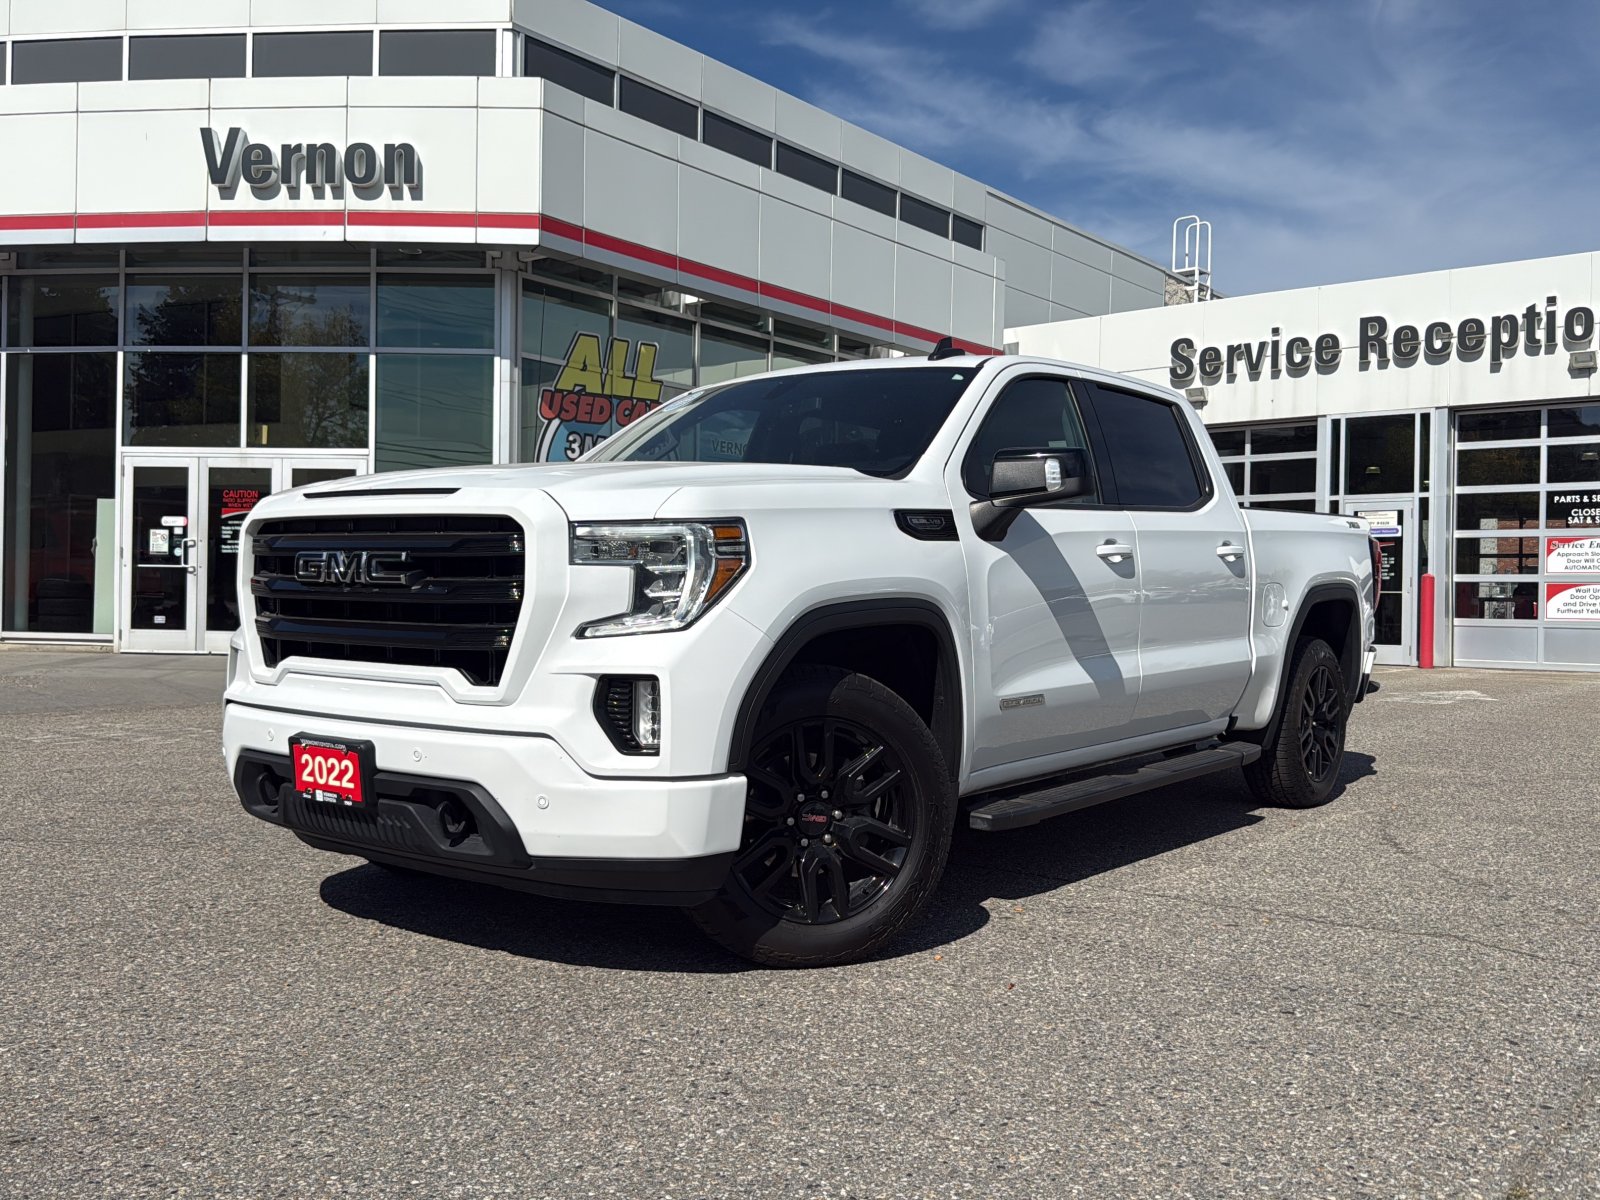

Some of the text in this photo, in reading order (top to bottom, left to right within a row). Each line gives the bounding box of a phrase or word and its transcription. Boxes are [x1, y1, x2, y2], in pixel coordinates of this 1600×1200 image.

[199, 126, 419, 188] Vernon
[555, 332, 664, 401] ALL
[1169, 326, 1342, 382] Service
[540, 389, 662, 427] USED CA
[222, 489, 259, 498] CAUTION
[1554, 495, 1580, 503] PARTS
[1582, 494, 1590, 503] &
[1567, 516, 1584, 524] SAT
[1586, 515, 1593, 524] &
[1551, 541, 1586, 549] Service
[294, 550, 408, 584] GMC
[300, 753, 355, 789] 2022
